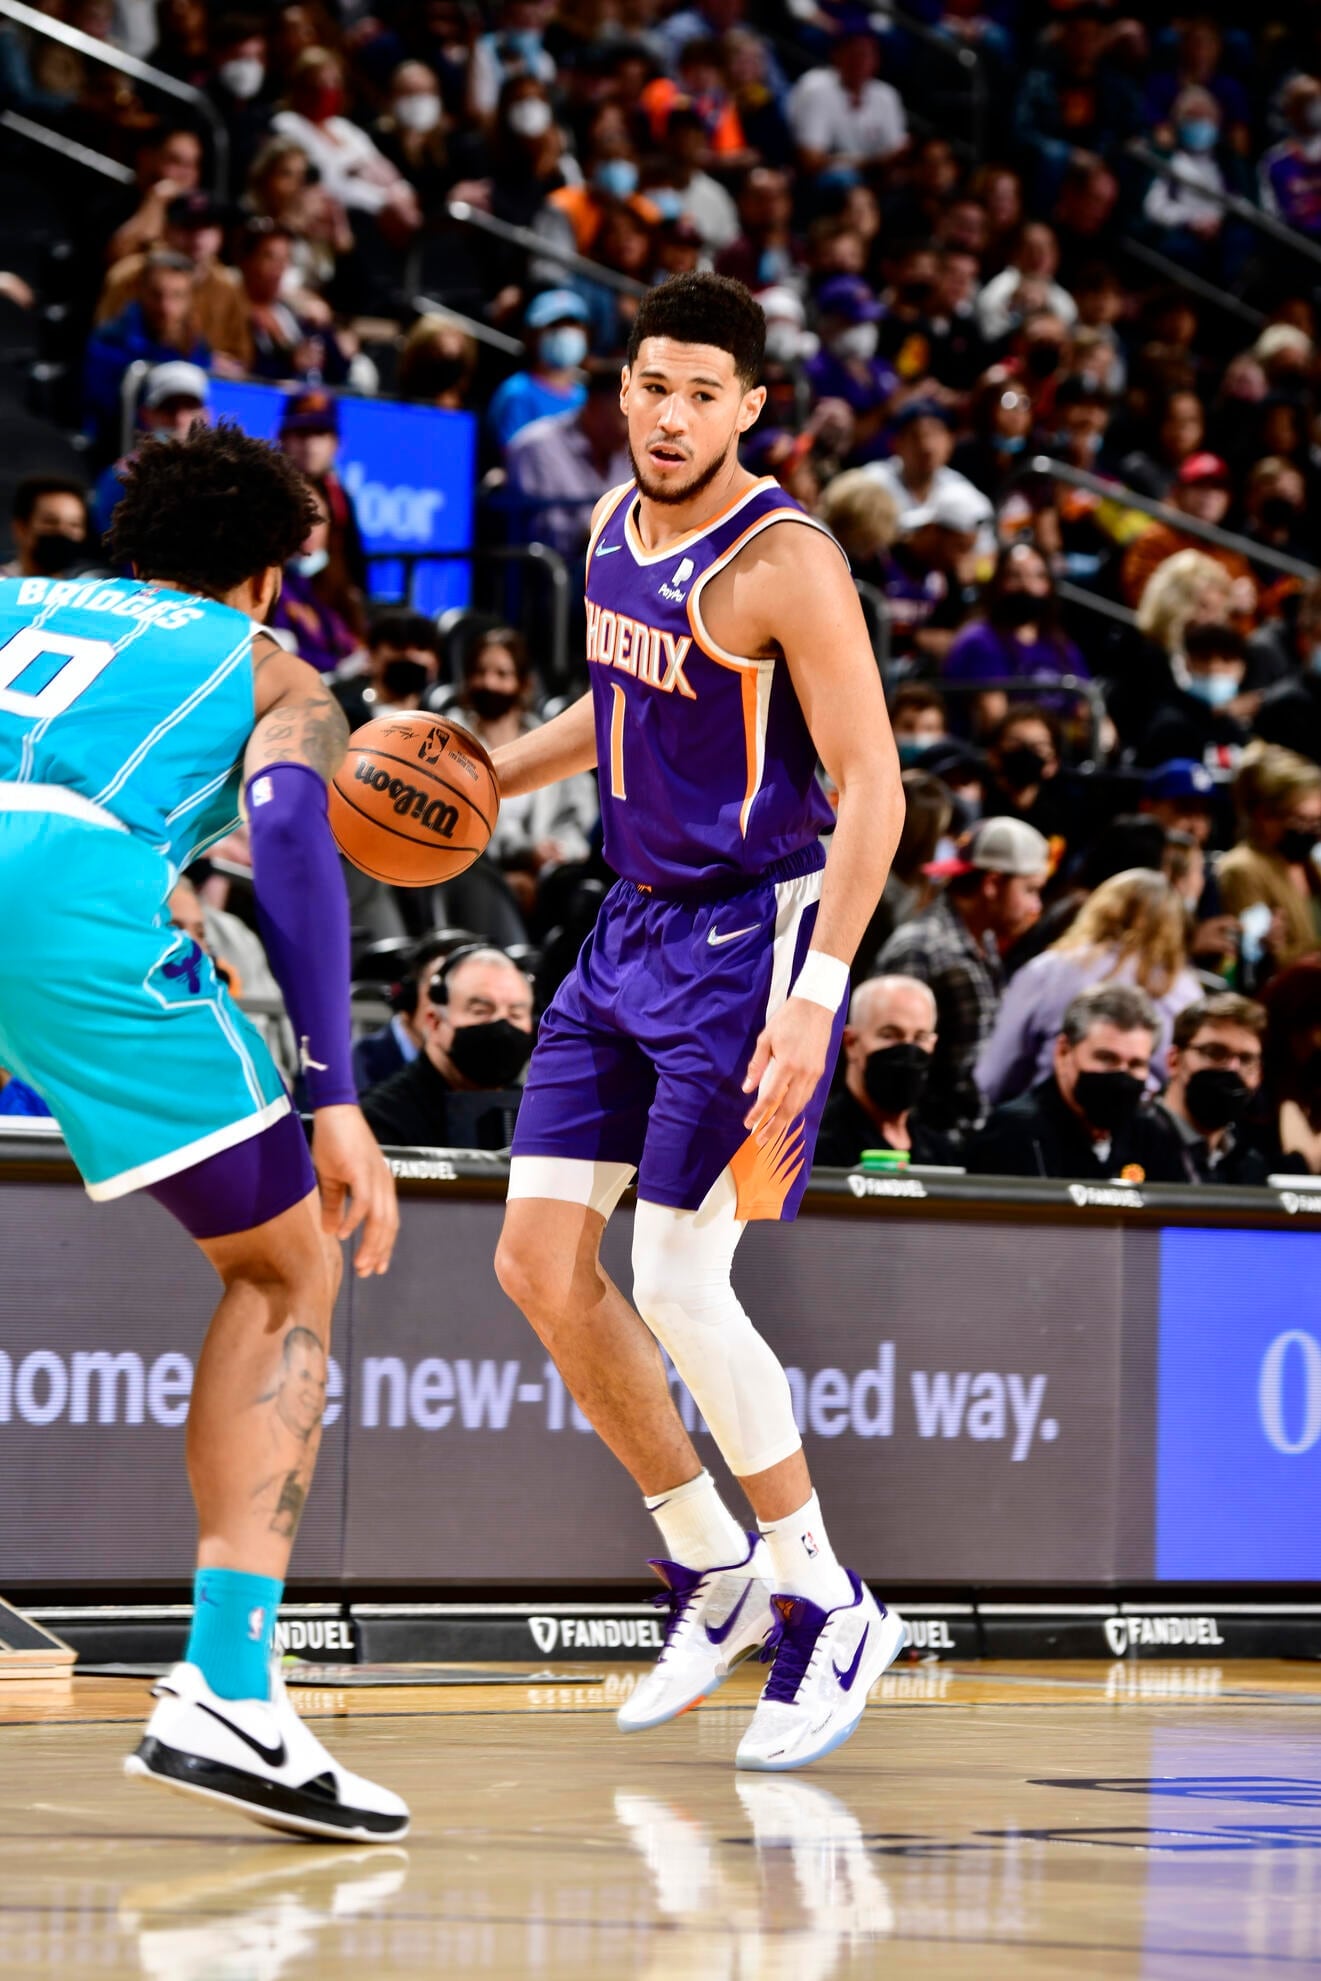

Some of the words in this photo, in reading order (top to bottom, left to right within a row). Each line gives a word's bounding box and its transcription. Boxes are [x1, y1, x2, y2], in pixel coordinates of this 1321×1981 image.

[16, 577, 206, 630] BRIDGES
[658, 582, 687, 603] PayPal
[584, 596, 698, 701] HOENIX
[610, 682, 627, 801] 1
[354, 759, 460, 839] Wilson
[911, 1370, 1060, 1461] way.
[273, 1621, 355, 1650] NDUEL
[560, 1619, 665, 1648] FANDUEL
[1127, 1617, 1225, 1646] FANDUEL
